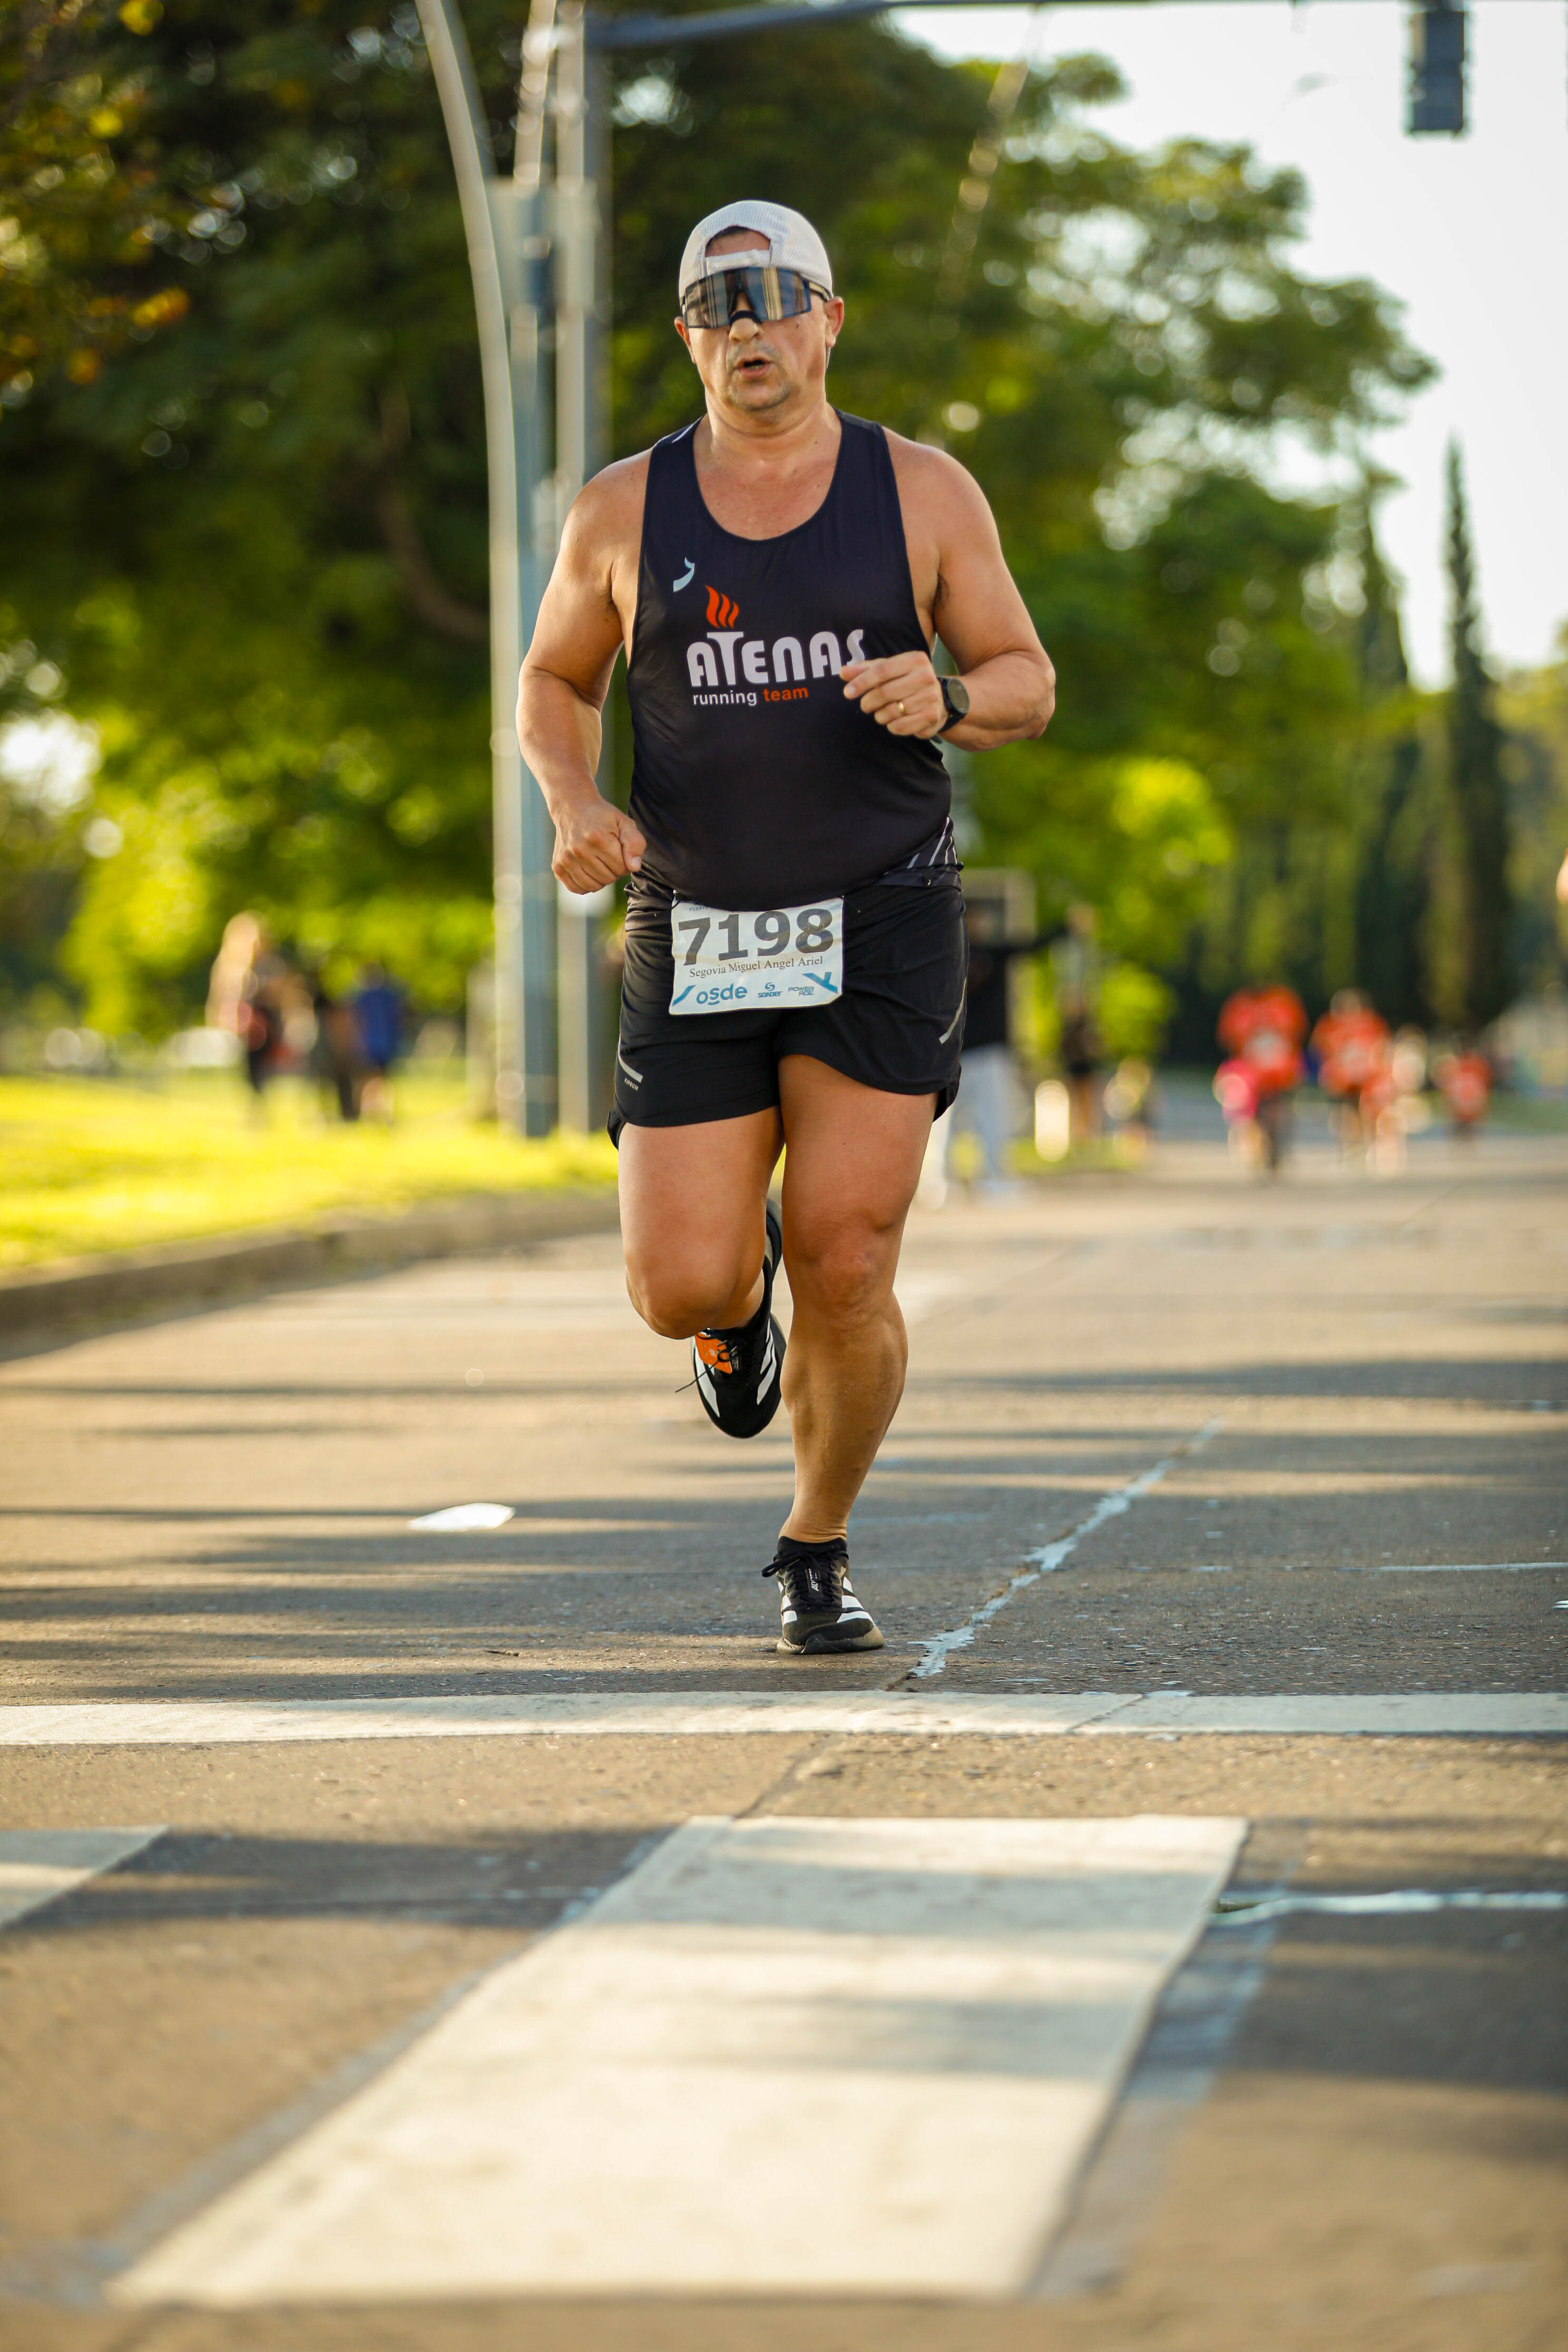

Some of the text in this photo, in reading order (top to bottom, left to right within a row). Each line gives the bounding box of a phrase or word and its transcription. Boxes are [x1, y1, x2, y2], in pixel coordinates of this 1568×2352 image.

[687, 629, 865, 687] ATENAS
[693, 687, 808, 705] running team
[678, 908, 834, 966] 7198
[690, 956, 823, 978] Segovia Miguel Angel Ariel
[696, 983, 748, 1006] osde
[624, 1077, 639, 1091] KIPRUN
